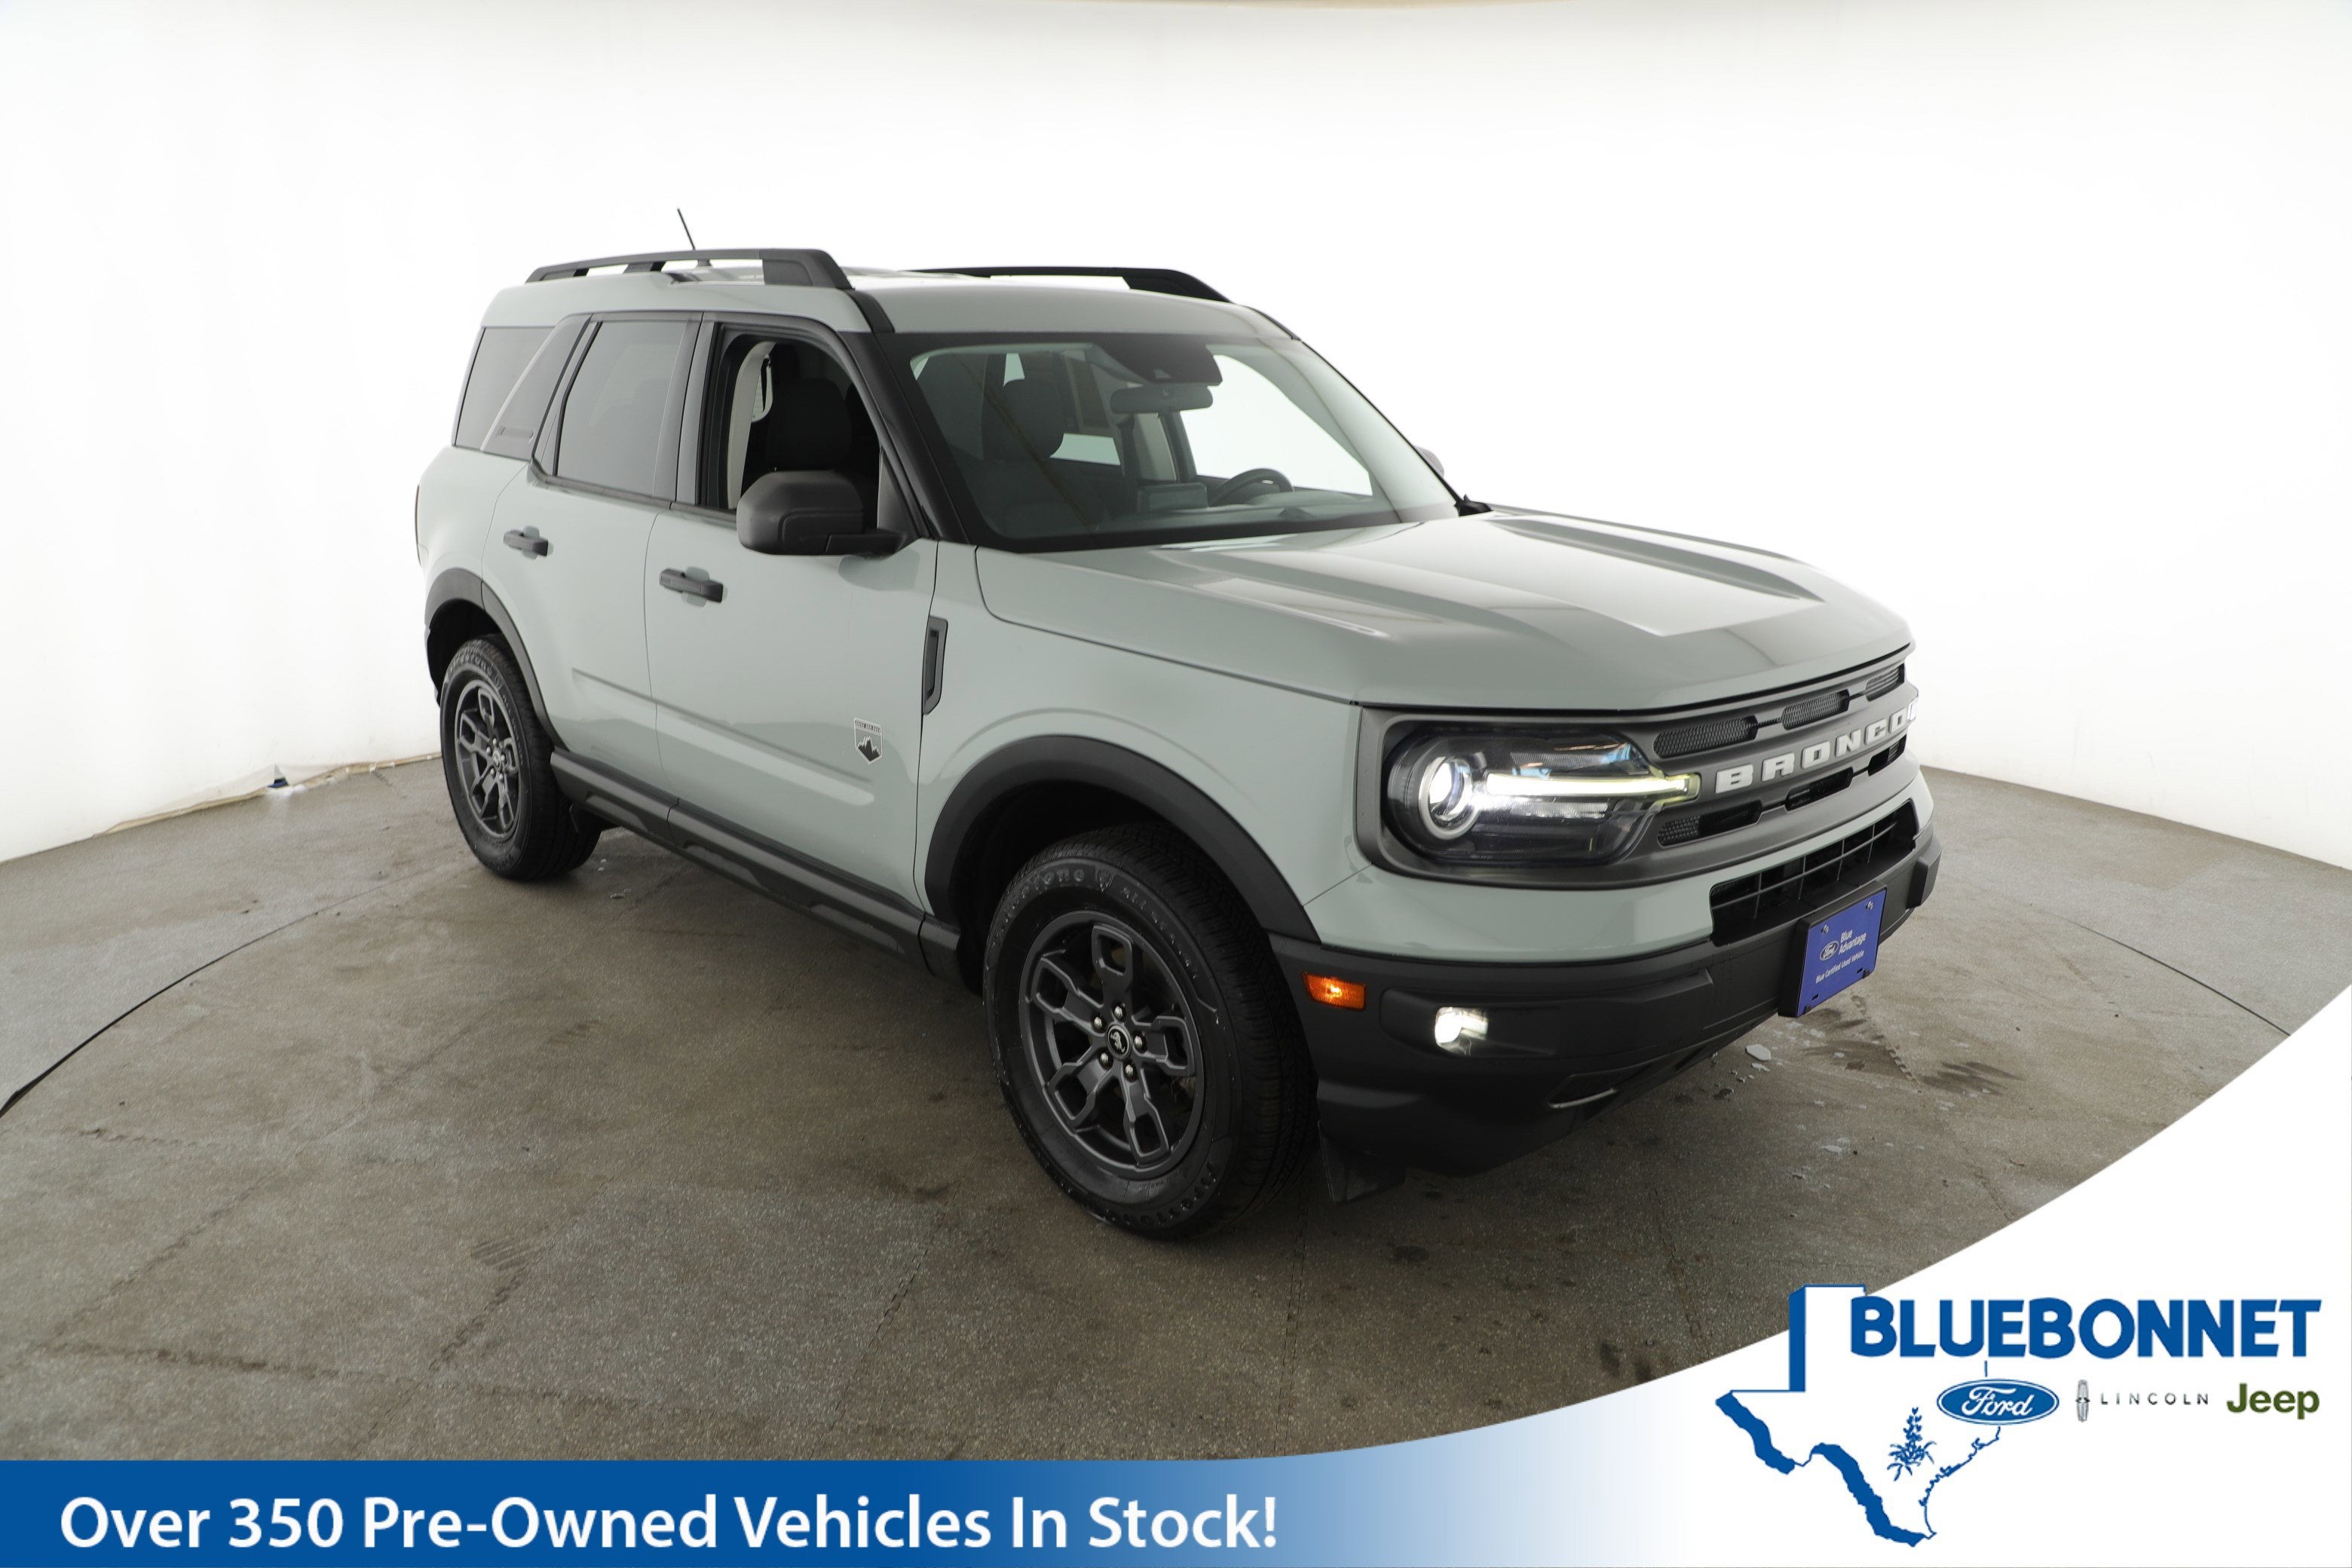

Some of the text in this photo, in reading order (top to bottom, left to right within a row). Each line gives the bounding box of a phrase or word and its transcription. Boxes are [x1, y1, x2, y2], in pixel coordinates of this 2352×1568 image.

[1715, 707, 1908, 794] BRONCO
[1839, 933, 1867, 955] Advantage
[1840, 929, 1853, 943] Blue
